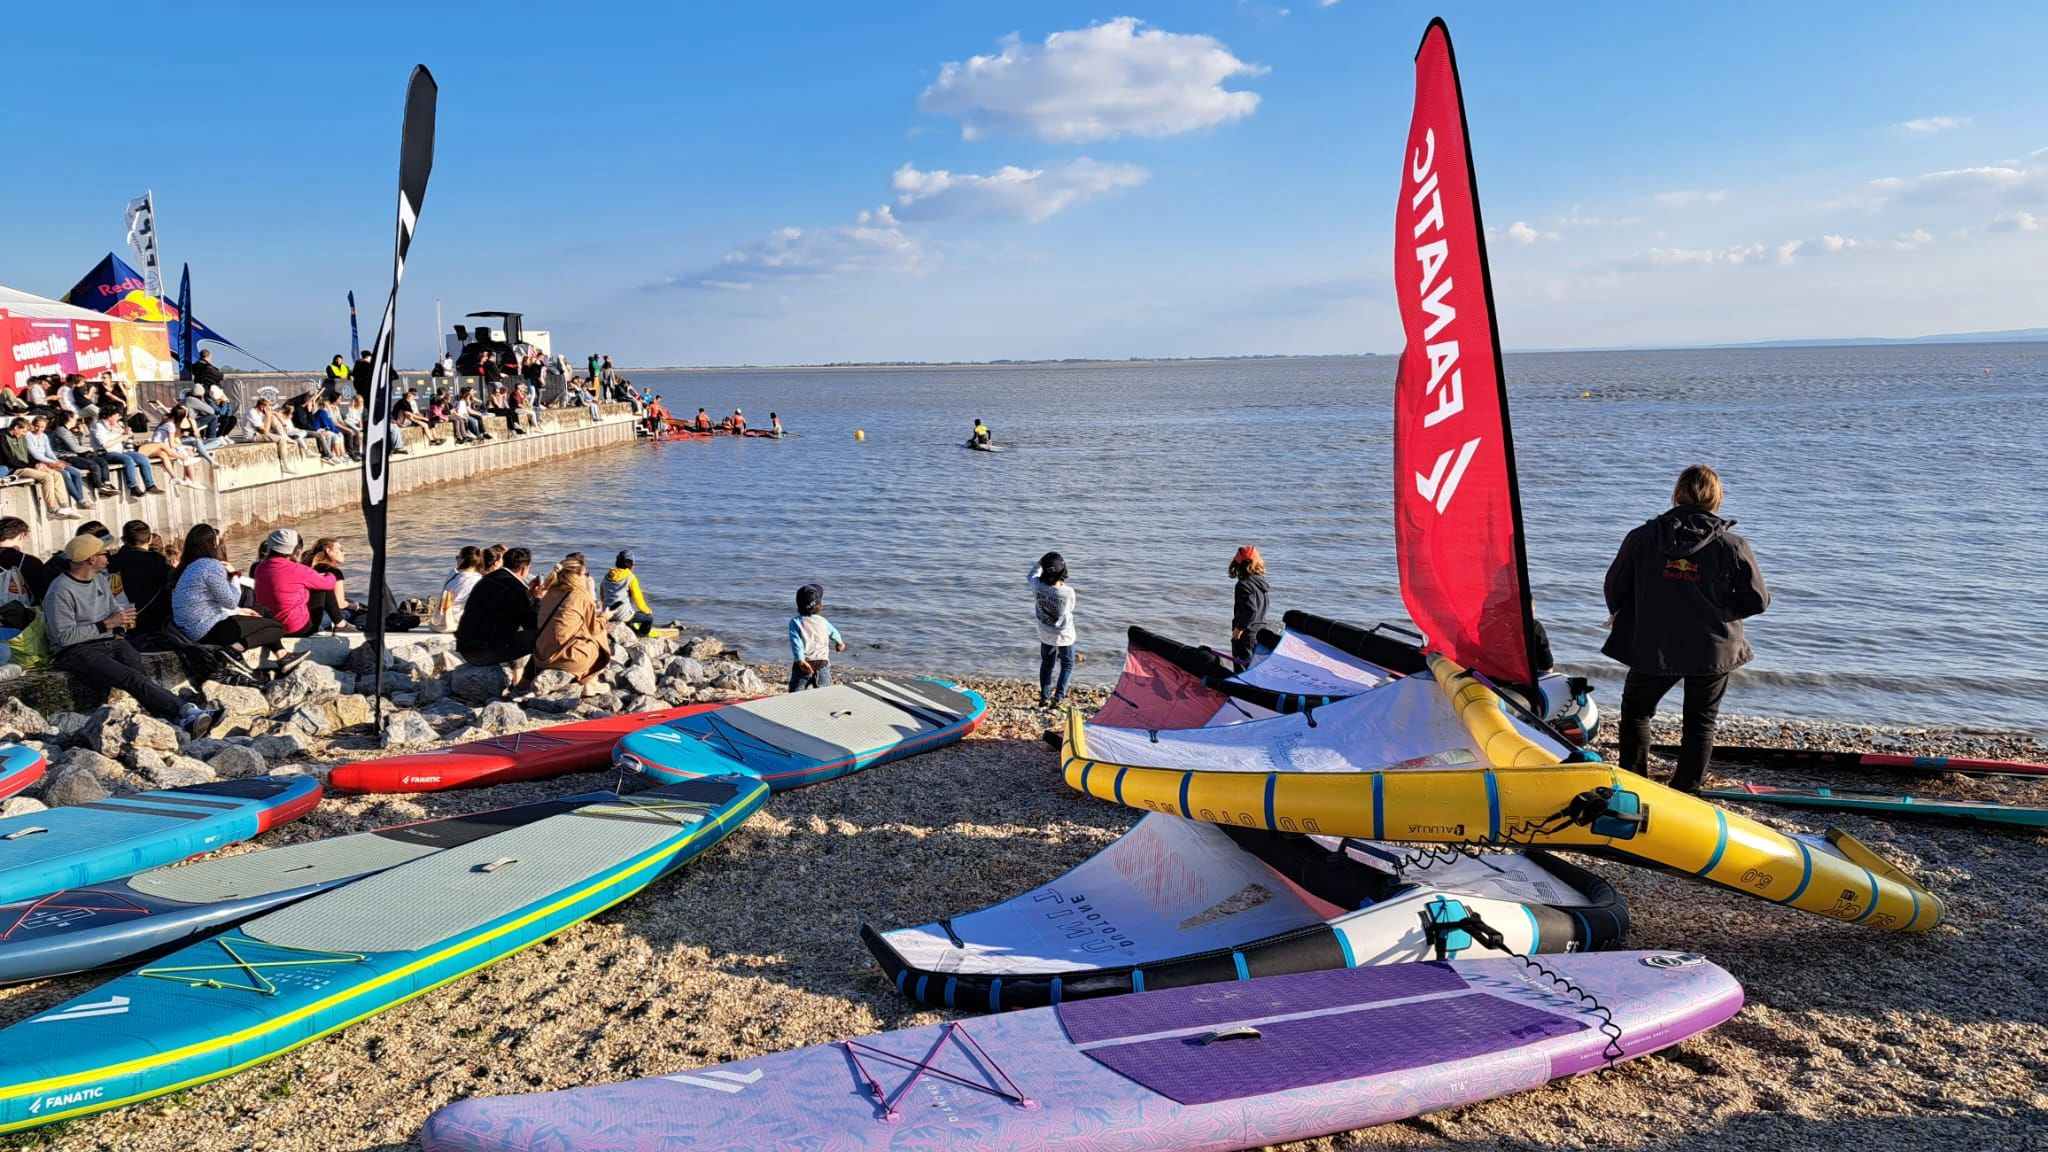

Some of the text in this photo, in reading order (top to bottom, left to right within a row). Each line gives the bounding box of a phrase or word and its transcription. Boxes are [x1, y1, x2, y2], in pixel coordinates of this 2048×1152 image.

[97, 278, 133, 297] Red
[13, 334, 67, 361] comes the
[75, 347, 111, 371] Nothing
[410, 776, 442, 784] FANATIC
[1740, 868, 1774, 890] 5.0
[45, 1086, 104, 1109] FANATIC
